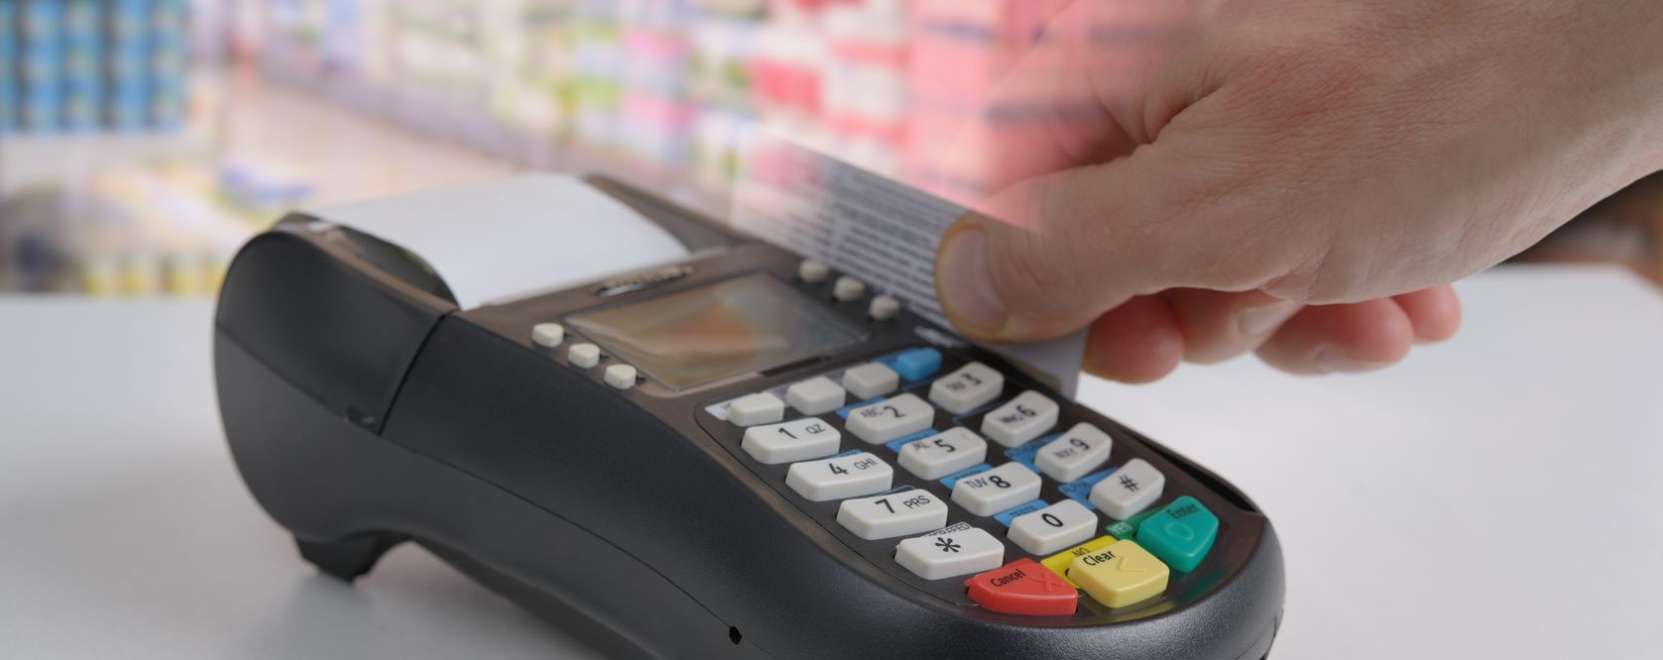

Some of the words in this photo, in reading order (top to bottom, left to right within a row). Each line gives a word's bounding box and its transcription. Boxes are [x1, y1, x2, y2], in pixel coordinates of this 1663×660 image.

[961, 373, 982, 386] 3
[883, 405, 906, 418] 2
[1016, 404, 1037, 418] 6
[778, 427, 798, 439] 1
[805, 424, 826, 435] QZ
[934, 439, 956, 453] 5
[1070, 438, 1090, 450] 9
[829, 463, 849, 475] 4
[853, 458, 880, 470] GHI
[963, 477, 988, 488] TUV
[989, 475, 1012, 489] 8
[875, 498, 895, 514] 7
[903, 495, 931, 509] PRS
[1041, 513, 1064, 528] 0
[1083, 551, 1117, 566] Clear
[989, 568, 1026, 588] Cancel
